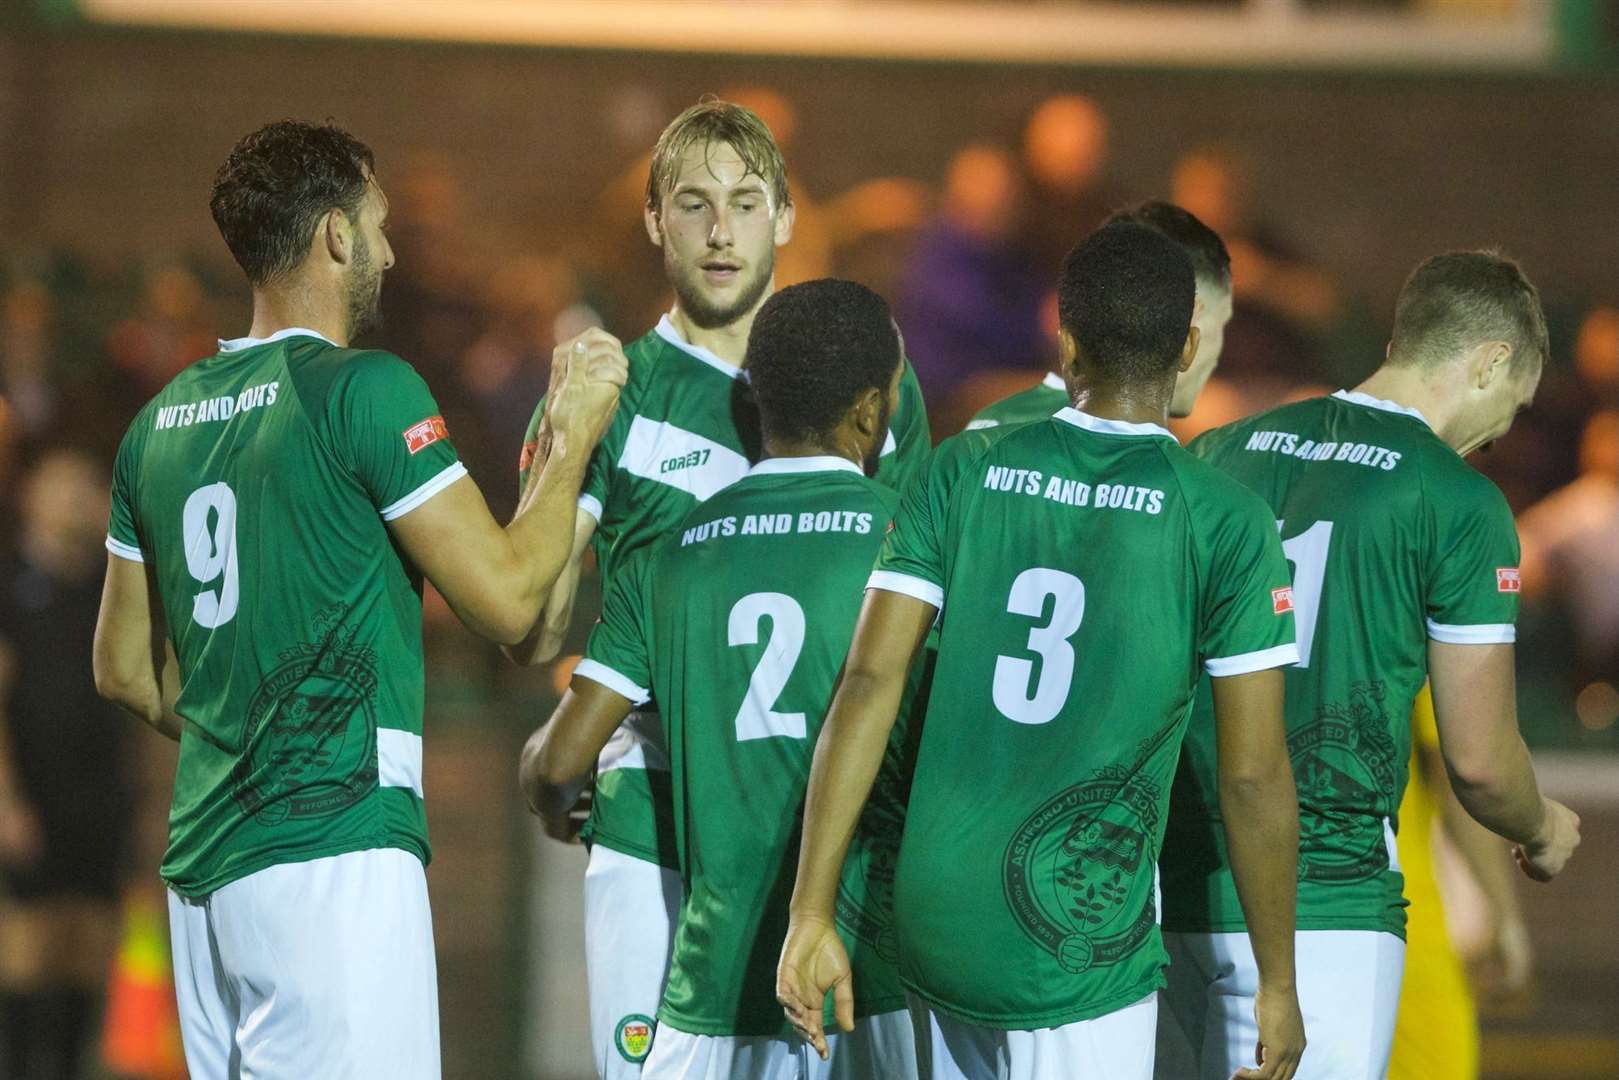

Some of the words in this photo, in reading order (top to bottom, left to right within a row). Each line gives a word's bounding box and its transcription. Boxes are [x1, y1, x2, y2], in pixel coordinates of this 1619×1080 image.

[155, 402, 196, 431] NUTS
[195, 396, 235, 424] AND
[1244, 431, 1299, 455] NUTS
[1294, 439, 1338, 461] AND
[1334, 442, 1402, 471] BOLTS
[984, 465, 1042, 496] NUTS
[1043, 476, 1092, 508] AND
[1094, 483, 1164, 515] BOLTS
[182, 481, 240, 629] 9
[681, 516, 736, 547] NUTS
[740, 513, 793, 535] AND
[797, 511, 873, 534] BOLTS
[727, 591, 807, 741] 2
[992, 567, 1086, 725] 3
[1011, 804, 1063, 867] ASHFORD
